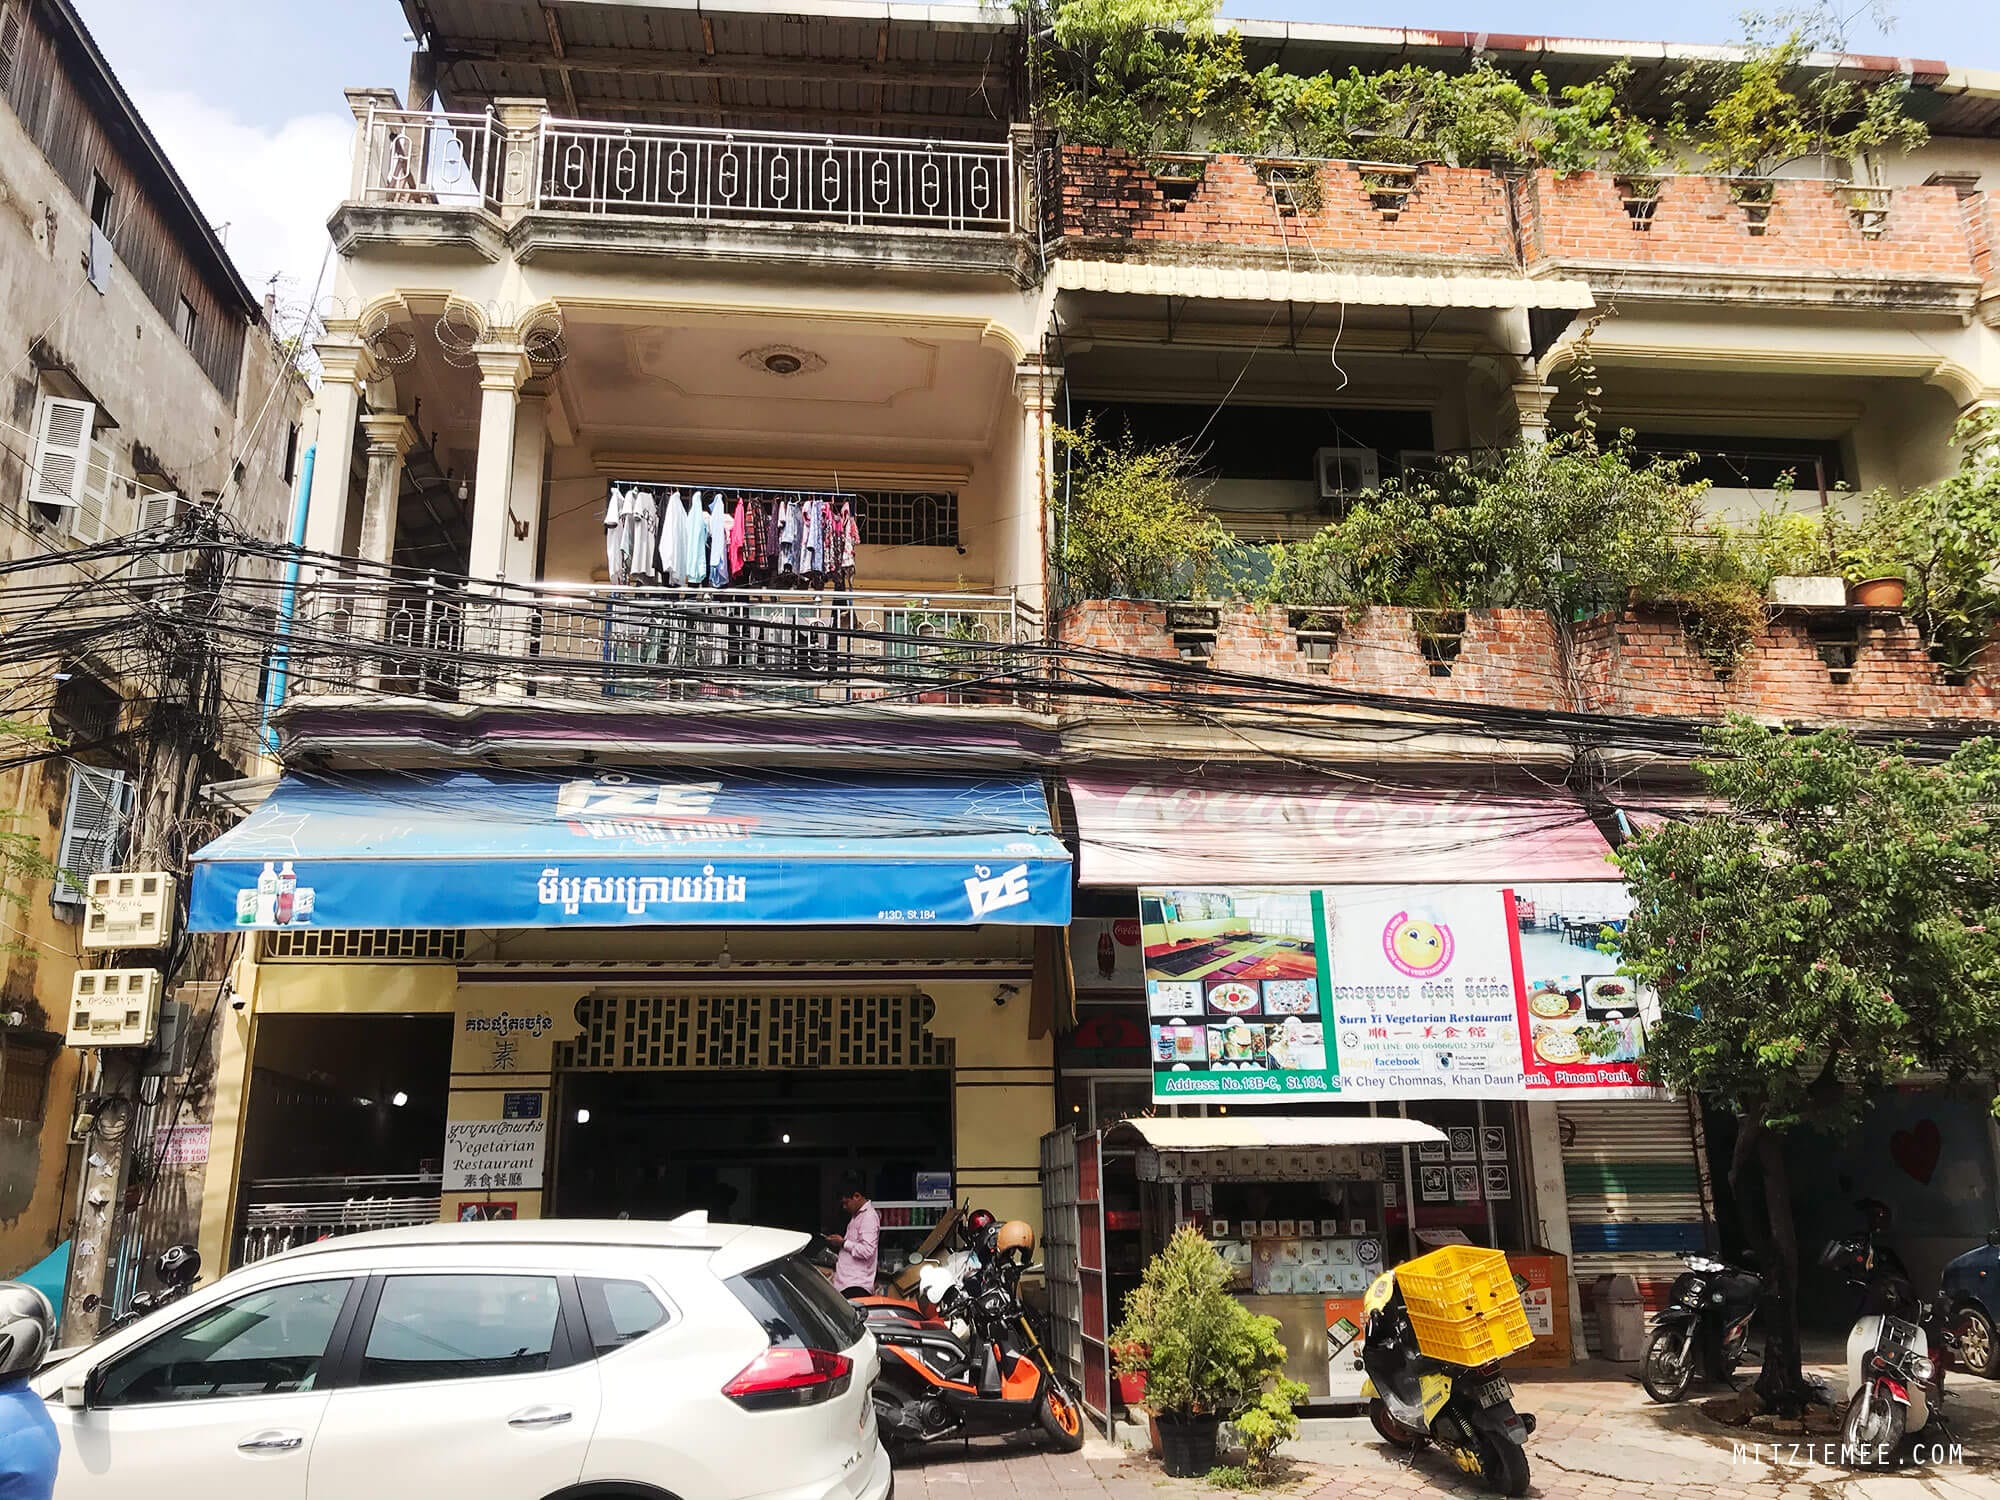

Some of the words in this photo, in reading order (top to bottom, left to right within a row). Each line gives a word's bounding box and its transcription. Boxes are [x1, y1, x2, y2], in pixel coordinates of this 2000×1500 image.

[964, 863, 1030, 918] IZE
[877, 910, 905, 921] #13D,
[1339, 1014, 1367, 1025] Surn
[1371, 1014, 1382, 1024] Yi
[1385, 1013, 1447, 1026] Vegetarian
[1449, 1012, 1513, 1024] Restaurant
[1363, 1042, 1380, 1051] HOT
[490, 1040, 519, 1071] 素
[1374, 1056, 1421, 1067] facebook
[1166, 1077, 1220, 1091] Address:
[1221, 1077, 1282, 1091] No.13B-C,
[1287, 1076, 1328, 1089] St.184,
[1332, 1075, 1353, 1088] S/K
[1356, 1075, 1385, 1090] Chey
[1388, 1074, 1446, 1088] Chomnas,
[1452, 1073, 1481, 1085] Khan
[1484, 1073, 1514, 1085] Daun
[1516, 1071, 1550, 1086] Penh,
[1555, 1070, 1596, 1084] Phnom
[1599, 1070, 1633, 1084] Penh,
[454, 1139, 535, 1157] Vegetarian
[453, 1157, 535, 1171] Restaurant
[463, 1172, 524, 1188] 素食餐廳
